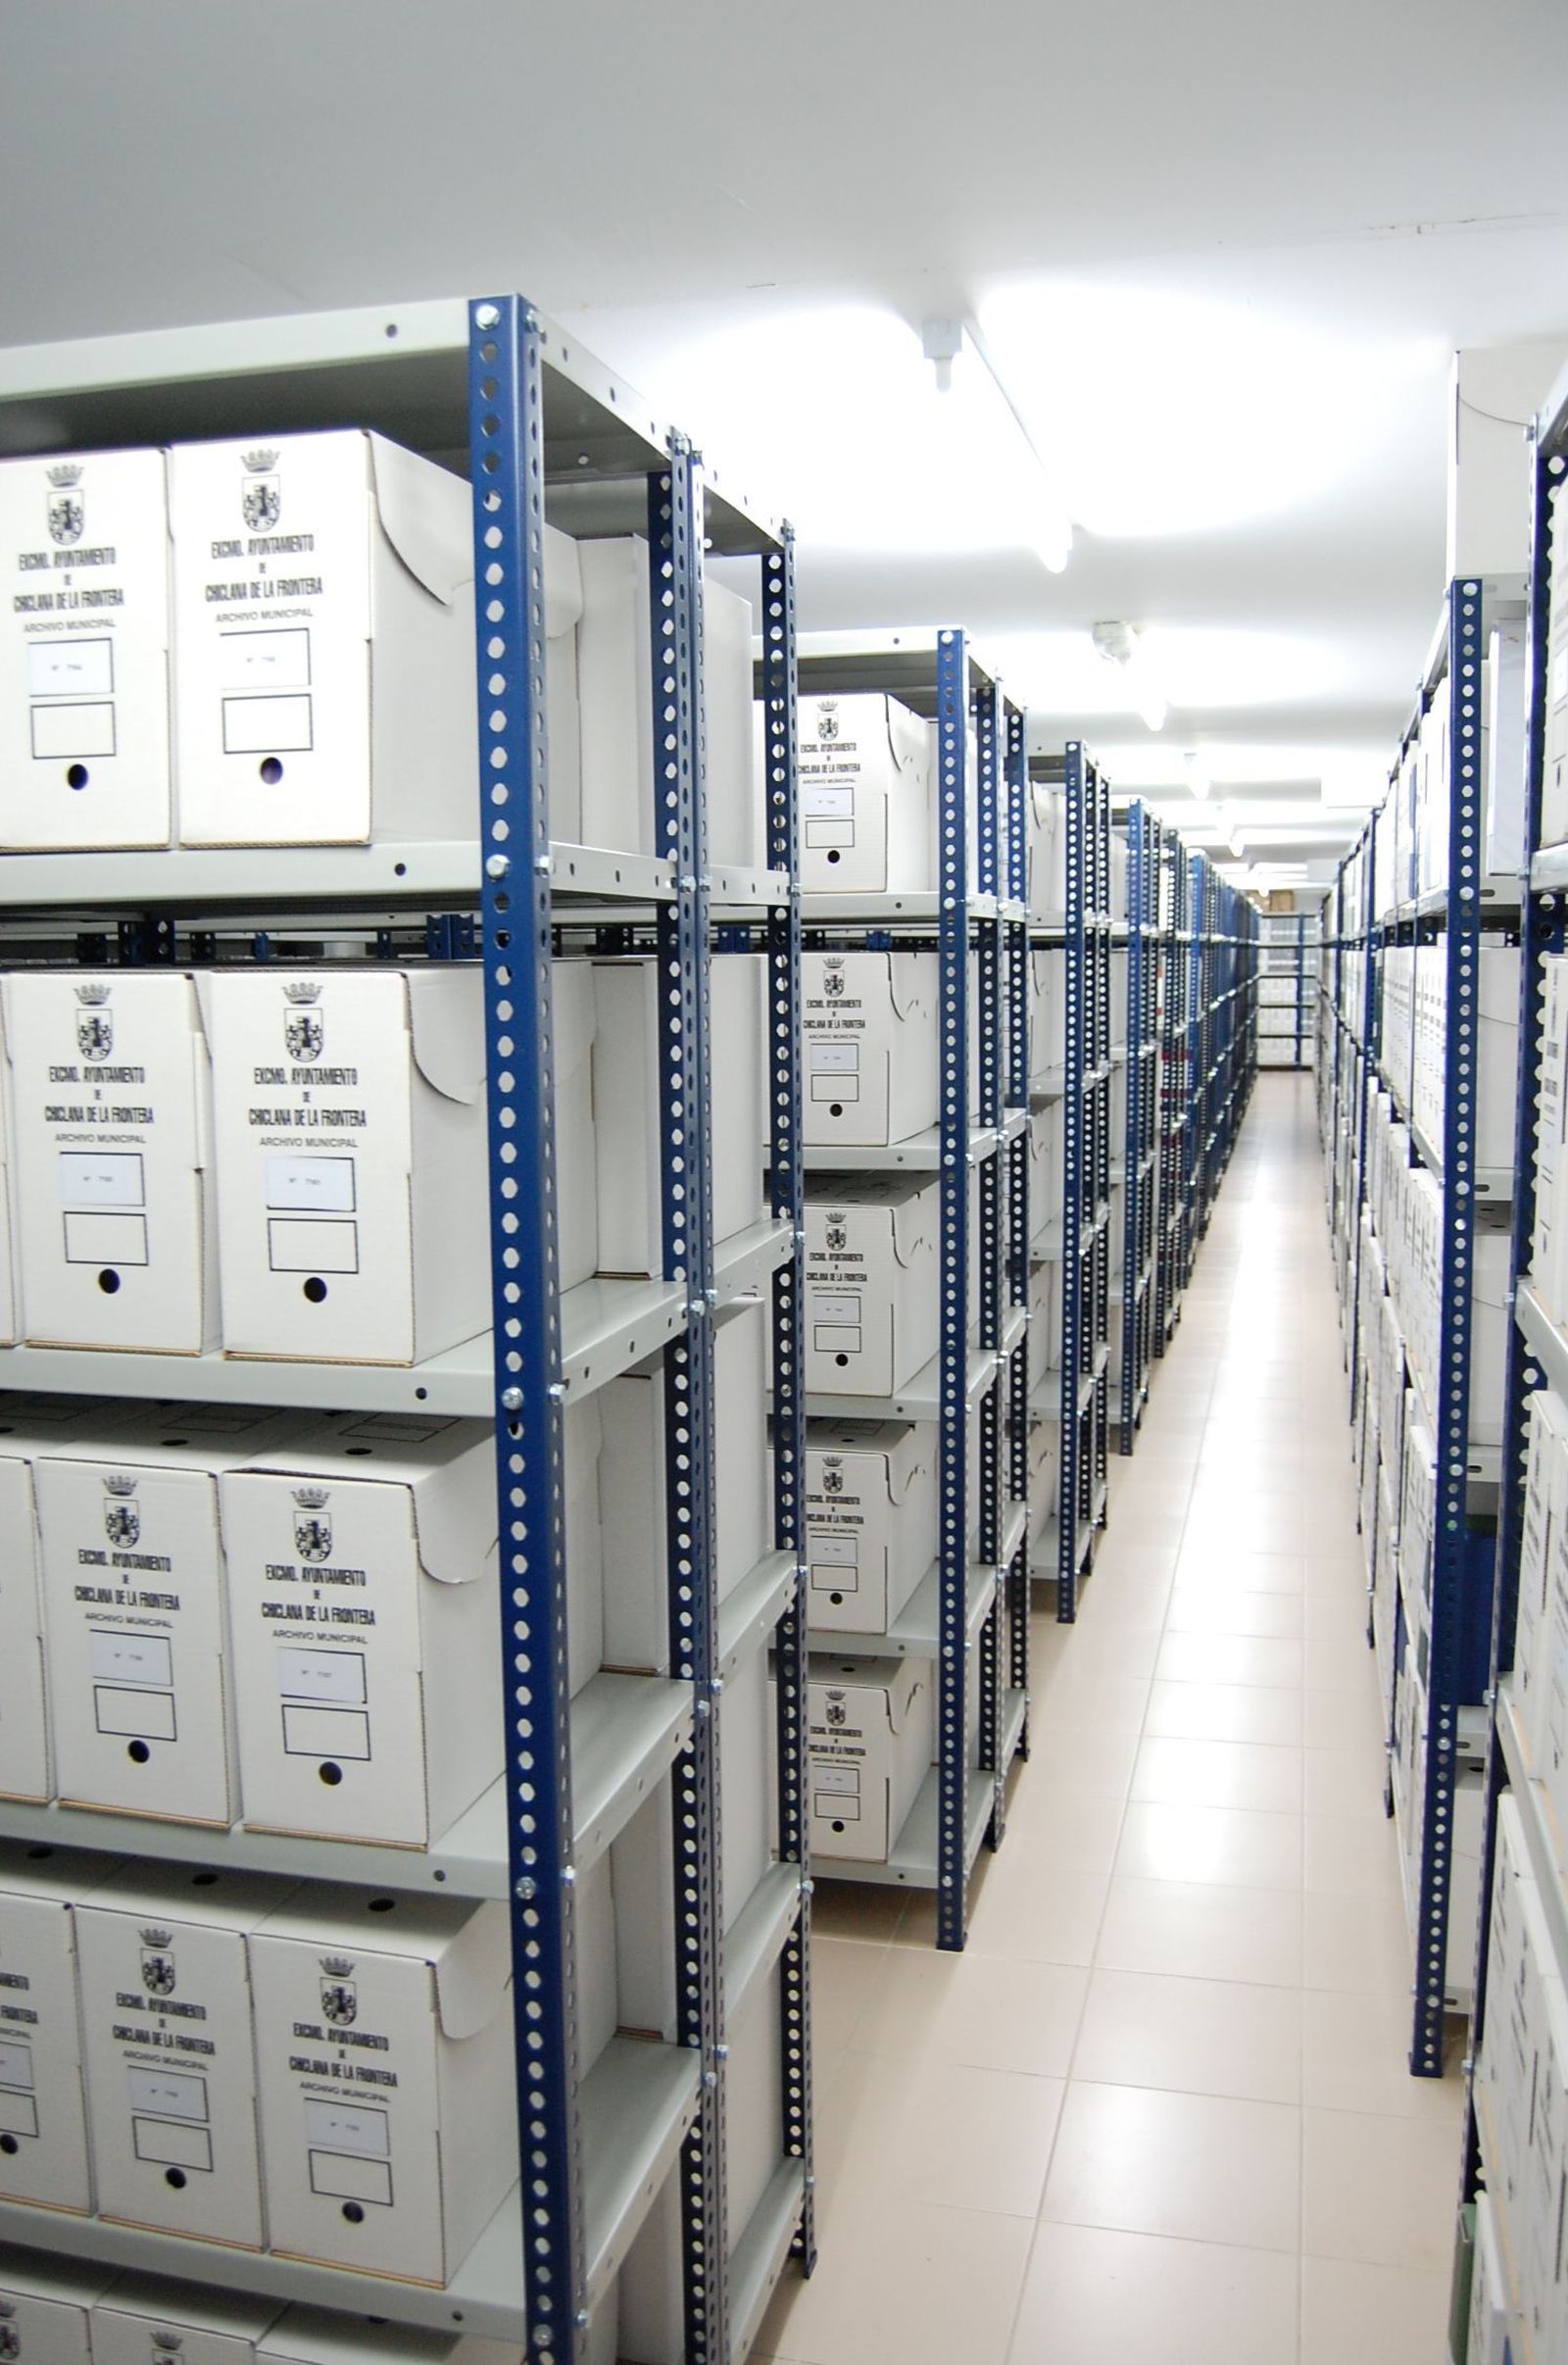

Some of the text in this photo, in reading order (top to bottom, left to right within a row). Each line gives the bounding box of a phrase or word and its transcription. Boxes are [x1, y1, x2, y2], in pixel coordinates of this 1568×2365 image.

[85, 1067, 146, 1084] AYUNTAMIENTO
[292, 1067, 358, 1085] AYUNTAMIENTO
[45, 1107, 155, 1123] CHICLANA DE LA FRONTERA
[249, 1109, 368, 1126] CHICLANA DE LA FRONTERA
[56, 1134, 147, 1143] ARCHIVO MUNICIPAL
[260, 1138, 360, 1148] ARCHIVO MUNICIPAL
[113, 1552, 172, 1572] AYUNTAMIENTO
[302, 1566, 367, 1586] AYUNTAMIENTO
[74, 1586, 180, 1610] CHICLANA DE LA FRONTERA
[85, 1612, 173, 1628] ARCHIVO MUNICIPAL
[262, 1602, 376, 1626] CHICLANA DE LA FRONTERA
[272, 1630, 368, 1644] ARCHIVO MUNICIPAL
